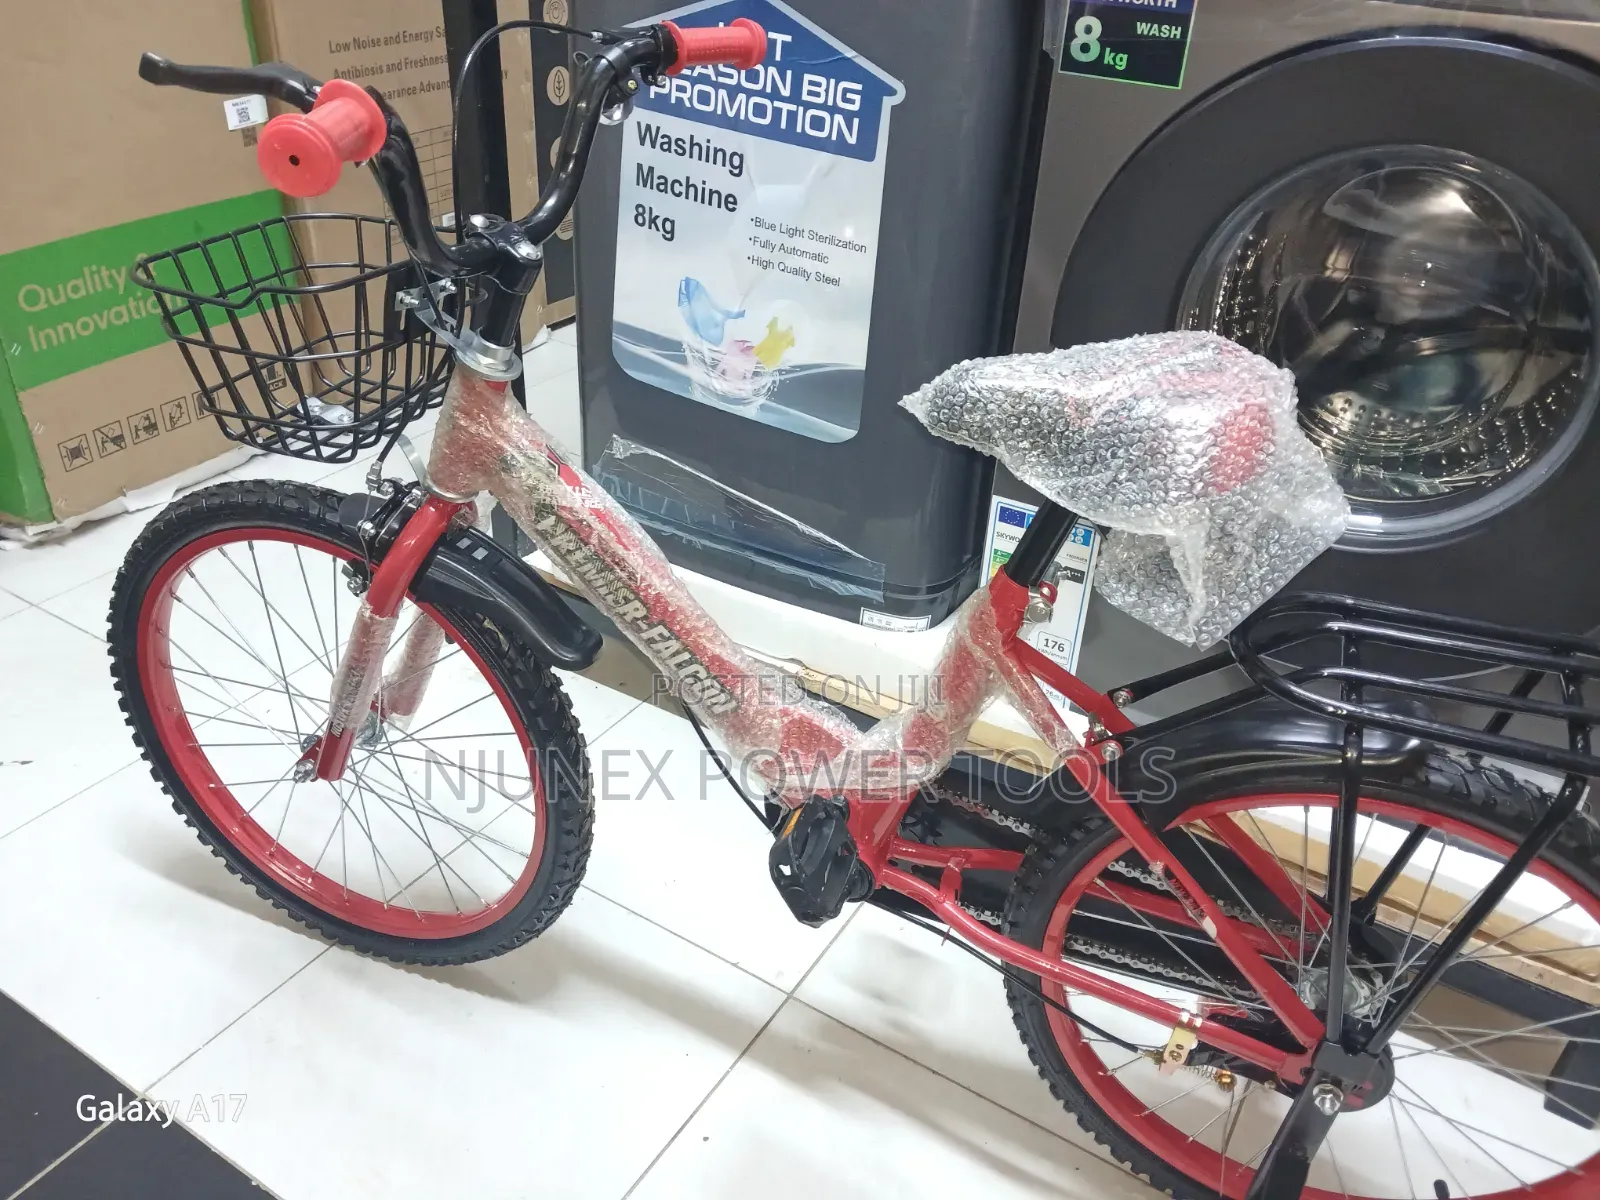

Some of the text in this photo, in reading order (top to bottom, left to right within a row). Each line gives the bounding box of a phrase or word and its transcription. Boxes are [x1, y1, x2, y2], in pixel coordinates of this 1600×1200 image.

[329, 39, 351, 54] Low
[352, 35, 381, 50] Noise
[383, 31, 400, 46] and
[402, 29, 434, 44] Energy
[1070, 16, 1128, 70] 8 kg
[1136, 22, 1181, 39] WASH
[333, 64, 384, 80] Antibiosis
[386, 58, 403, 73] and
[677, 62, 863, 112] ASON BIG
[649, 77, 859, 145] PROMOTION
[636, 121, 744, 178] Washing
[635, 162, 738, 213] Machine
[633, 203, 676, 242] 8kg
[754, 217, 867, 254] Blue Light Sterilization
[753, 236, 829, 264] Fully Automatic
[18, 264, 127, 312] Quality
[751, 255, 841, 287] High Quality Steel
[1043, 638, 1065, 653] 176
